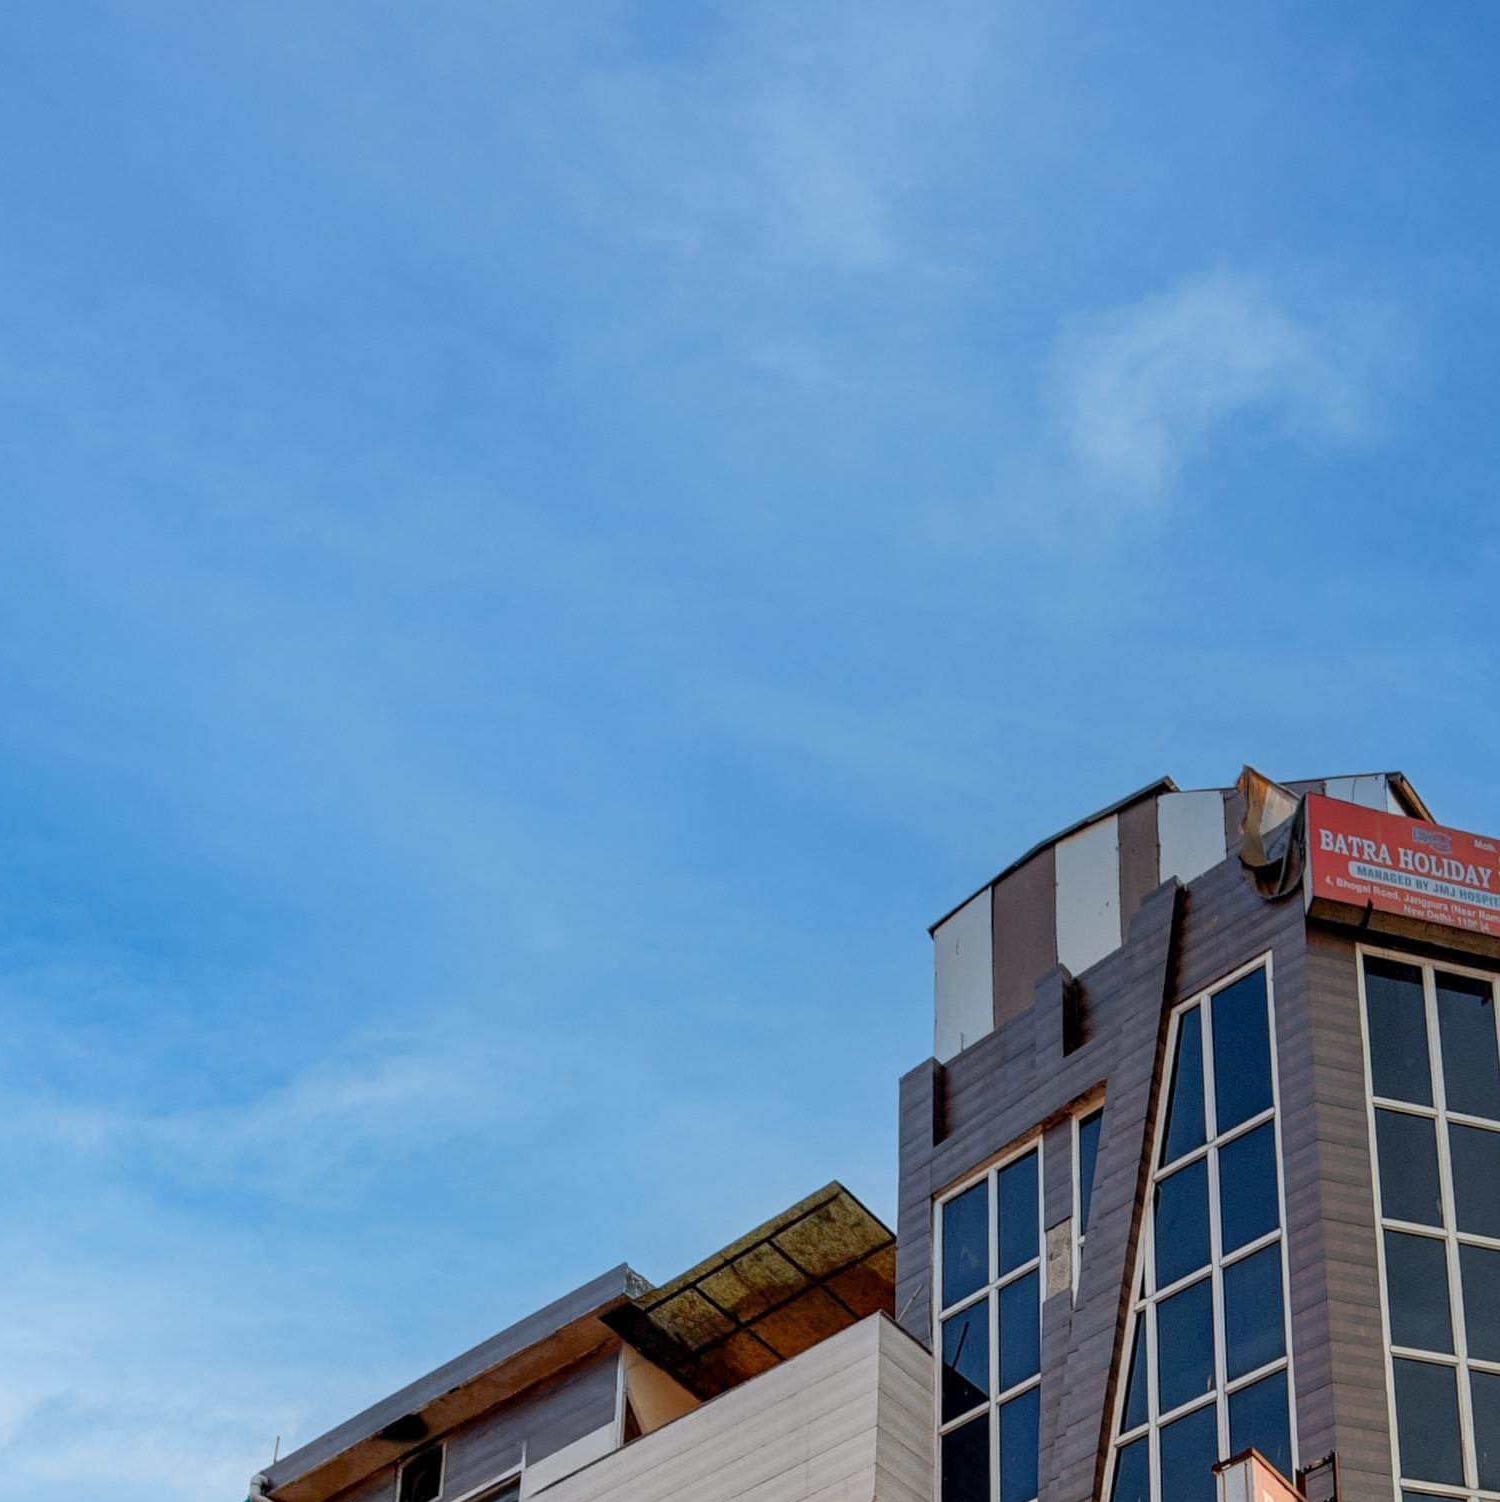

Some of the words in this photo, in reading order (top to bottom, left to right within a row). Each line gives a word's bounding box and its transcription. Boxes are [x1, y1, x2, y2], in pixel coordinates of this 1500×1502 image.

[1318, 828, 1393, 866] BATRA
[1397, 847, 1492, 889] HOLIDAY
[1356, 865, 1412, 887] MANAGED
[1415, 881, 1430, 892] BY
[1432, 883, 1456, 898] JMJ
[1403, 904, 1426, 917] New
